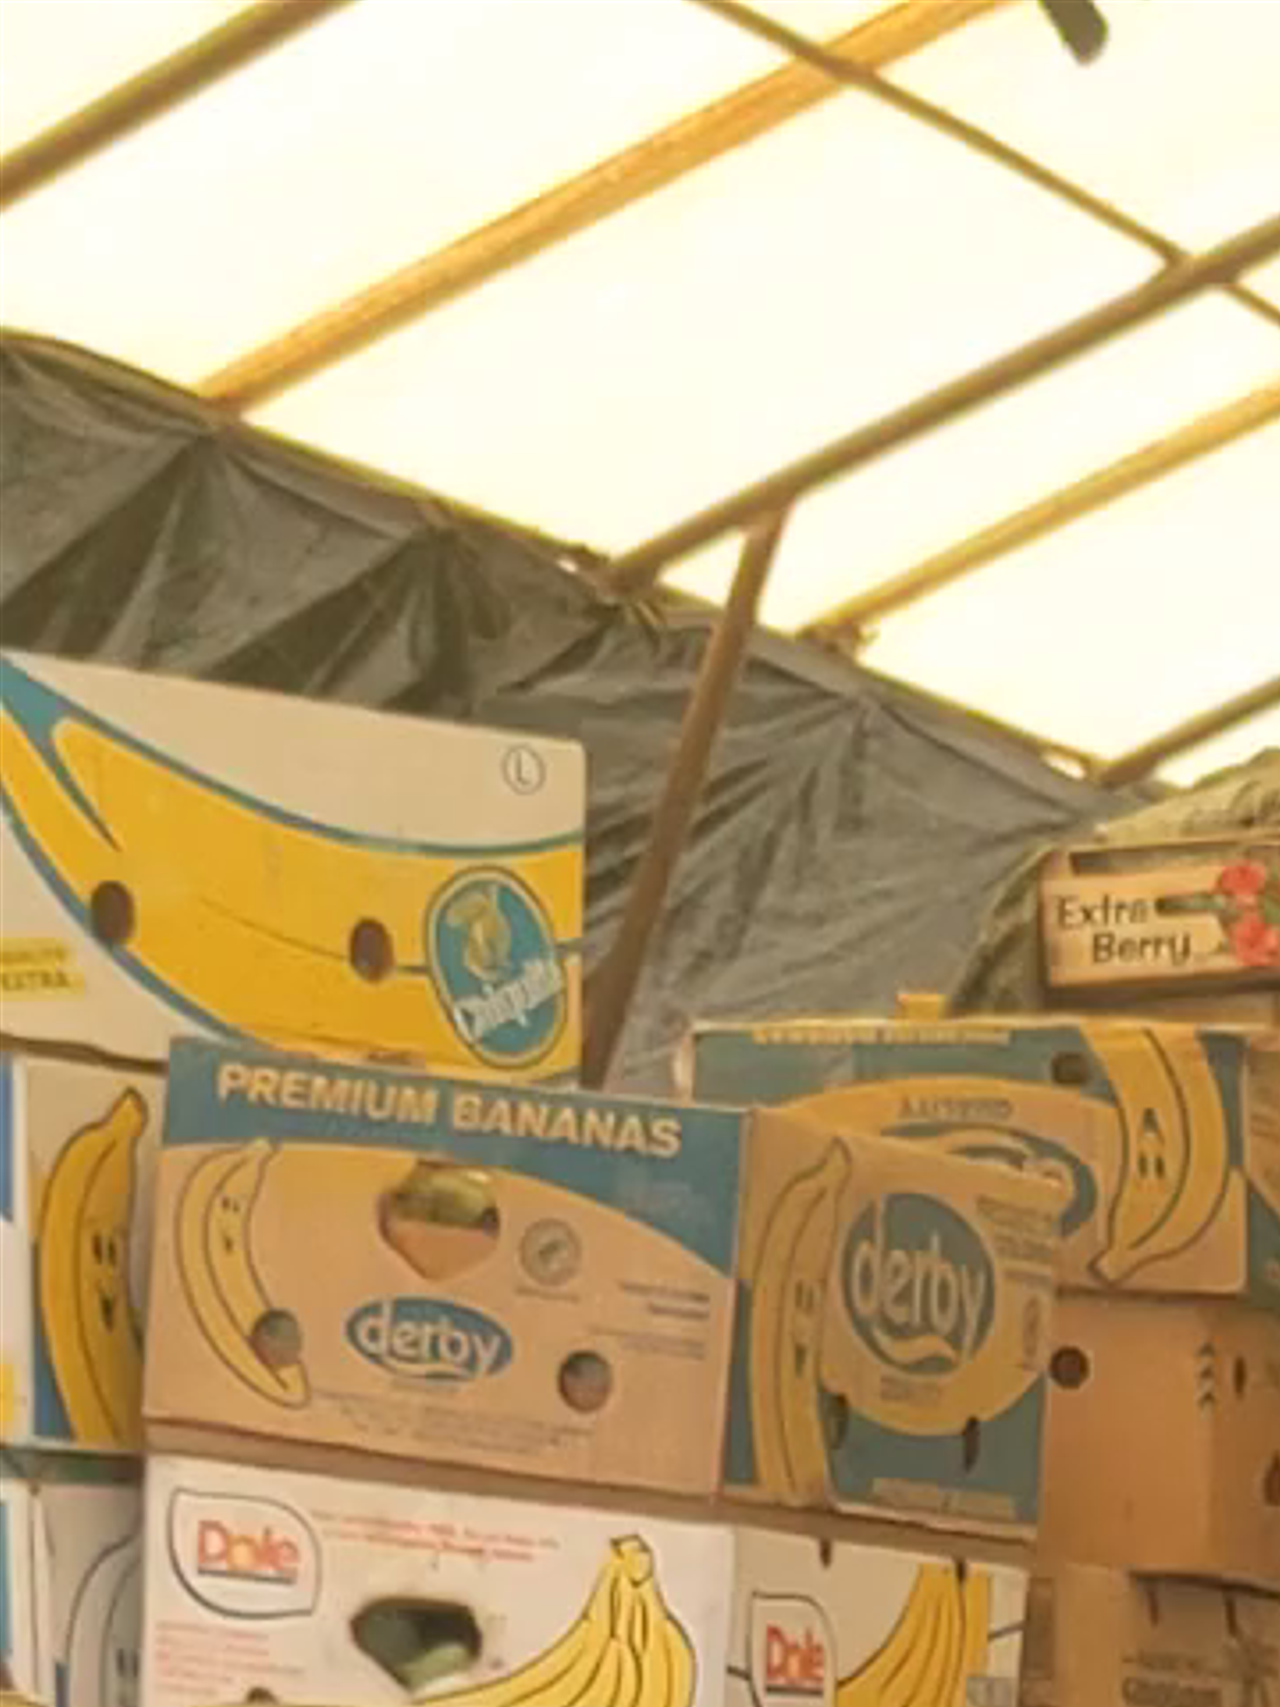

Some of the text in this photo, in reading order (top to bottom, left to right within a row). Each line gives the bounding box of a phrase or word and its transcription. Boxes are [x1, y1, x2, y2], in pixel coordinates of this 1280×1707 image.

[1057, 894, 1149, 929] Extra
[1092, 932, 1191, 967] Berry
[217, 1063, 681, 1158] PREMIUM BANANAS
[853, 1194, 986, 1364] derby
[355, 1294, 502, 1376] derby
[197, 1519, 299, 1573] Dole
[766, 1623, 824, 1683] Dole
